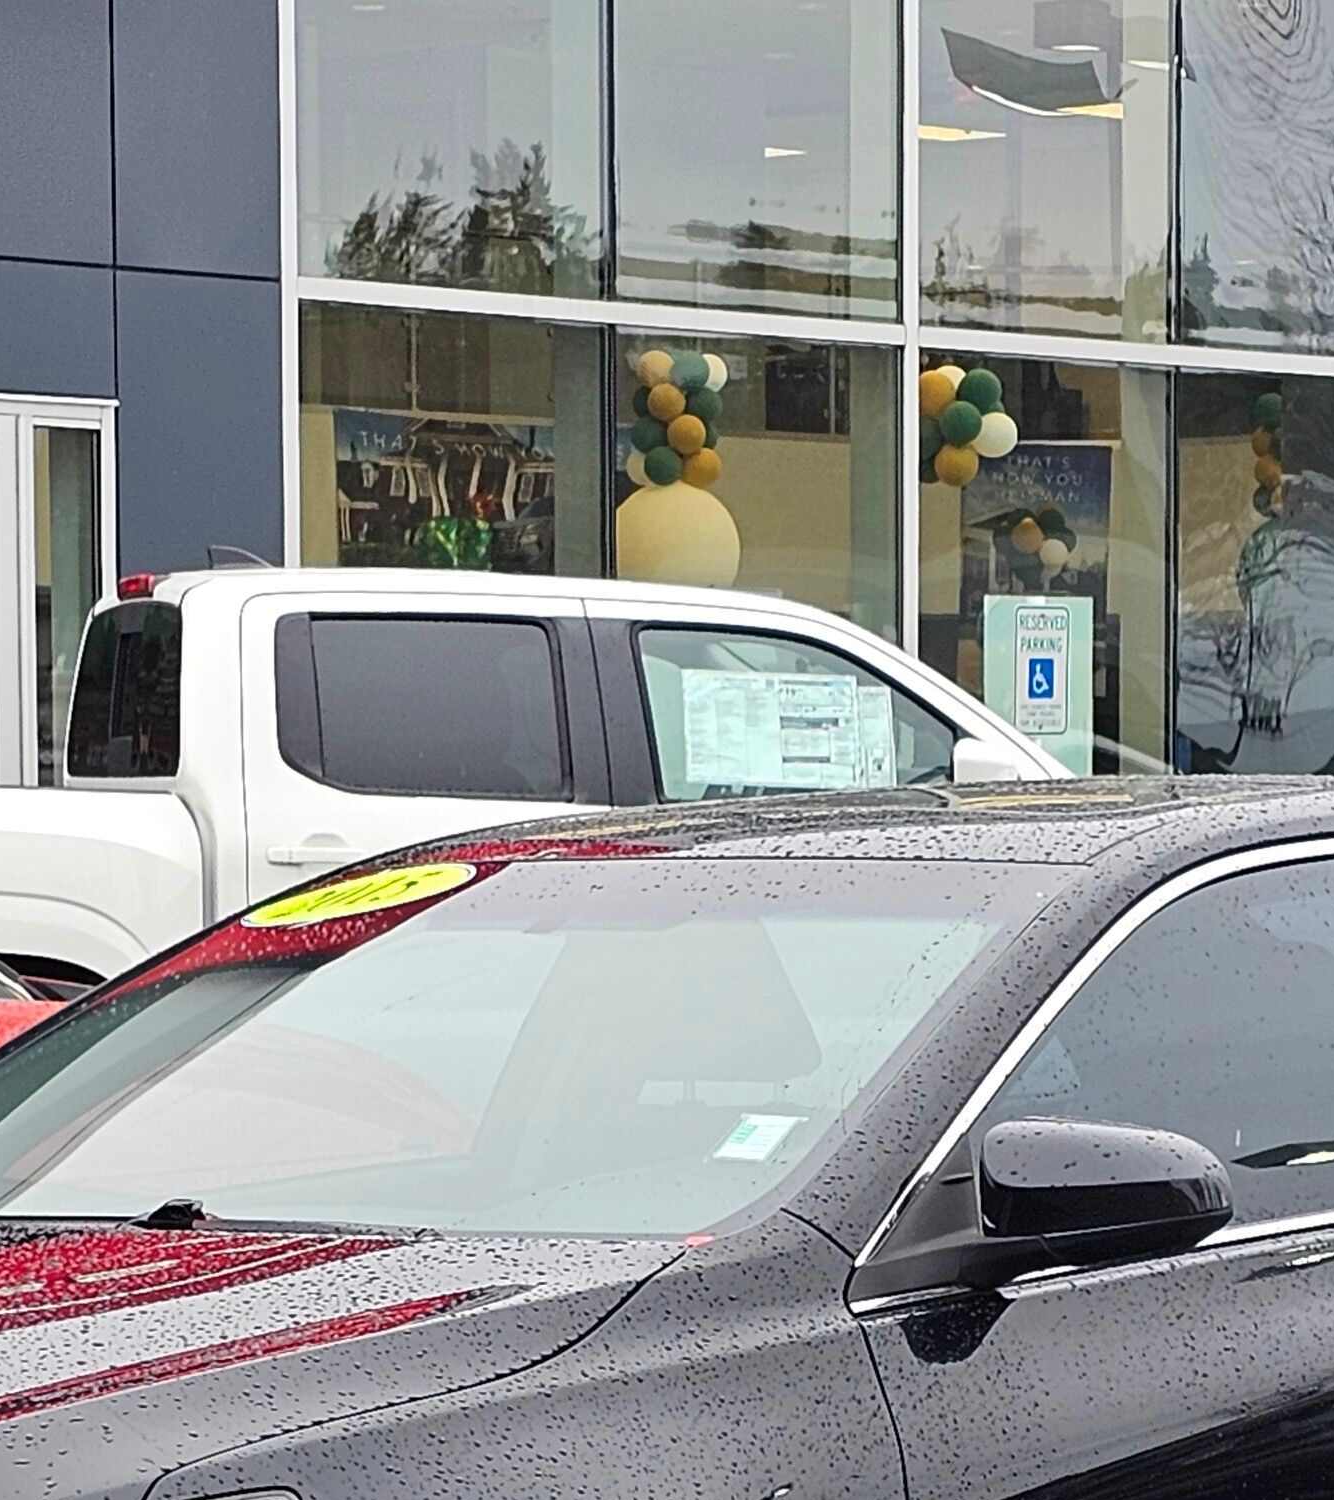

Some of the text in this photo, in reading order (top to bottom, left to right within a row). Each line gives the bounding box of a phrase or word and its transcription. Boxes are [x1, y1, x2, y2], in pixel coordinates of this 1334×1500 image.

[361, 430, 445, 456] THATS
[991, 471, 1083, 487] HOW YOU
[1019, 614, 1067, 631] RESERVED
[1020, 636, 1063, 654] PARKING
